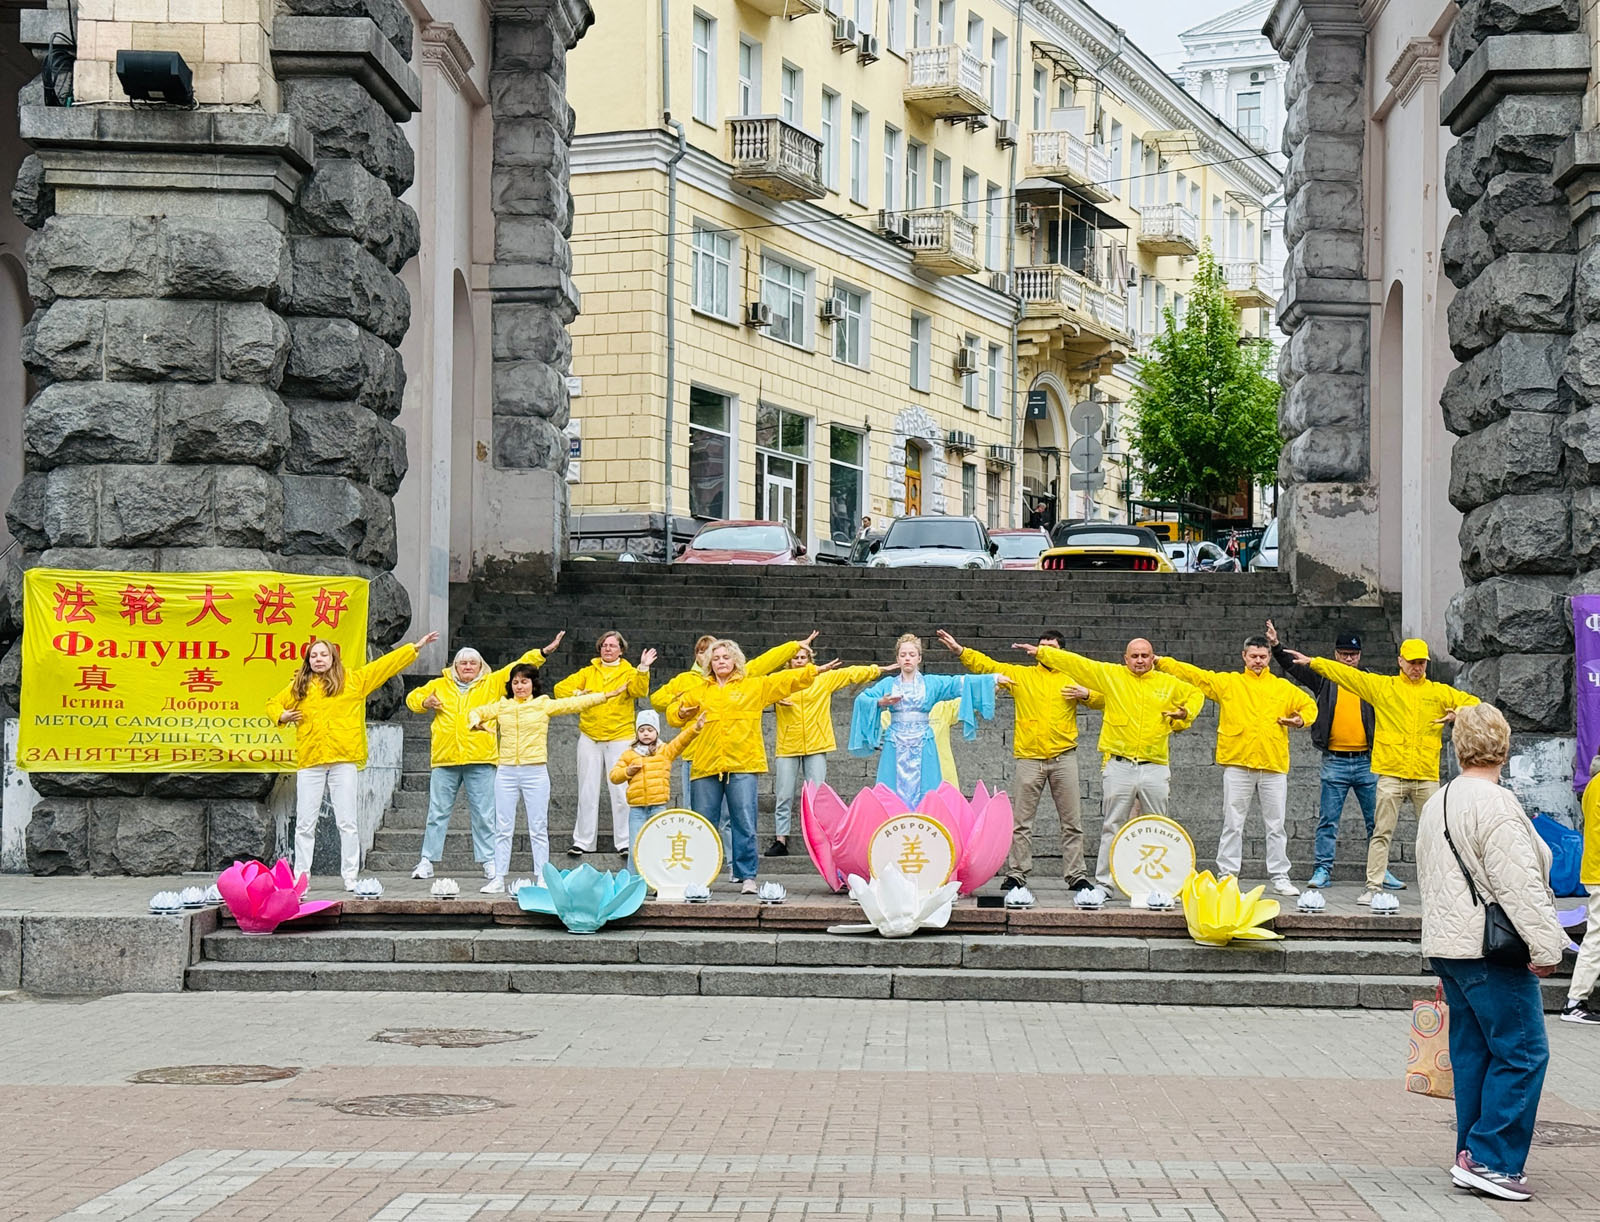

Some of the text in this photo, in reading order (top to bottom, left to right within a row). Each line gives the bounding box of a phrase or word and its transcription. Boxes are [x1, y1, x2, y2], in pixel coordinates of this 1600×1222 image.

[52, 630, 342, 667] Фалунь Да
[73, 664, 223, 693] 真 善
[62, 695, 239, 713] Істина Доброта
[34, 715, 109, 728] МЕТОД
[128, 732, 283, 745] ДУШІ ТА ТІЛА
[26, 747, 298, 763] ЗАНЯТТЯ БЕЗКОШ
[656, 817, 703, 831] ІСТИНА
[884, 822, 938, 838] ДОБРОТА
[662, 831, 694, 871] 真
[897, 834, 930, 874] 善
[1132, 844, 1171, 880] 忍
